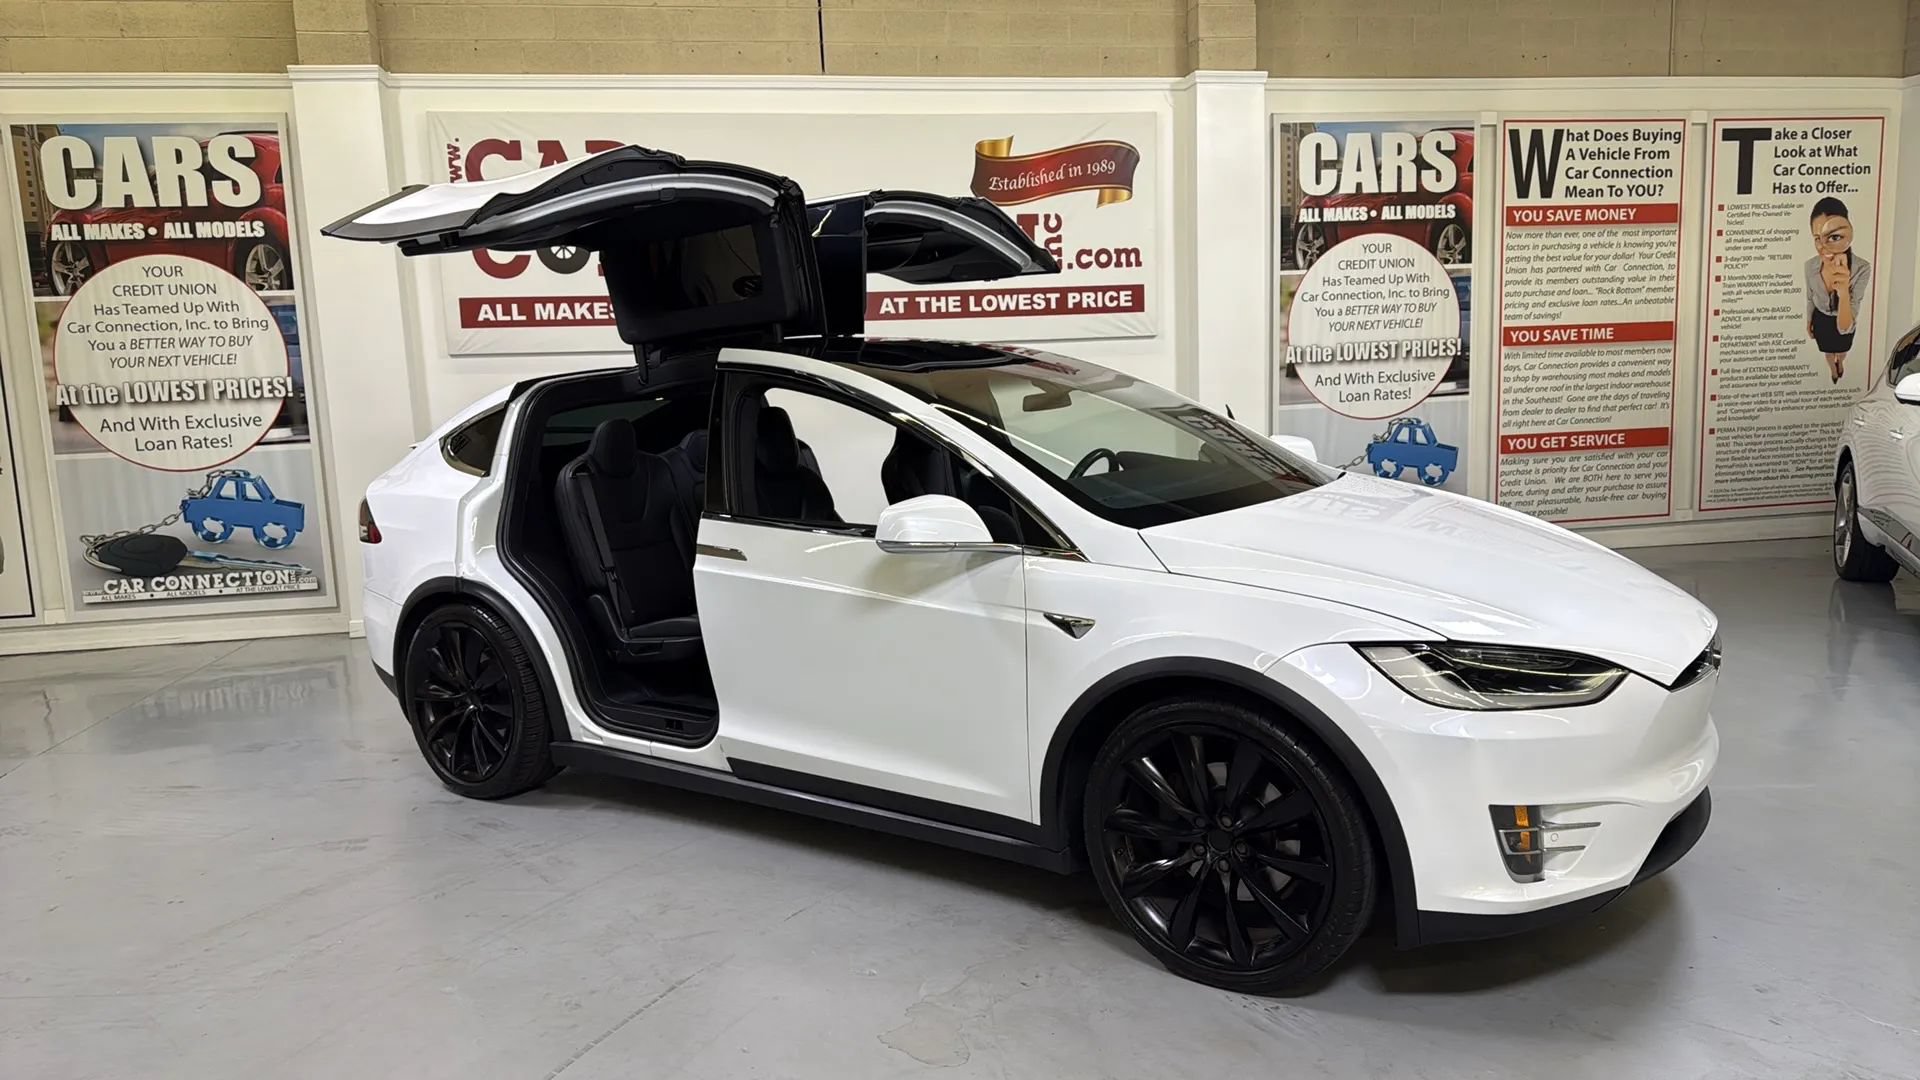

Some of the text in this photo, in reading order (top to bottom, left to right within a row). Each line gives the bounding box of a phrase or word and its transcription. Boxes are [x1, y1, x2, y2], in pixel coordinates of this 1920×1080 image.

[1594, 129, 1628, 141] Does
[1633, 129, 1681, 144] Buying
[1812, 127, 1851, 139] Closer
[1566, 147, 1670, 160] A Vehicle From
[1774, 145, 1857, 158] Look at What
[1299, 131, 1457, 196] CARS
[1774, 163, 1870, 176] Car Connection
[40, 135, 261, 209] CARS
[989, 160, 1115, 190] Established in 1989
[1565, 166, 1672, 179] Car Connection
[1565, 184, 1664, 198] Mean To YOU?
[1773, 181, 1858, 194] Has to Offer...
[1299, 205, 1456, 222] ALL MAKES ALL MODELS
[1513, 208, 1636, 222] YOU SAVE MONEY
[51, 221, 265, 240] ALL MAKES ALL MODELS
[1044, 213, 1062, 270] nc
[1067, 247, 1142, 269] .com
[1362, 243, 1392, 253] YOUR
[1541, 242, 1581, 251] purchasing
[1623, 241, 1653, 249] knowing
[1338, 258, 1415, 270] CREDIT UNION
[142, 266, 184, 277] YOUR
[1323, 273, 1429, 286] Has Teamed Up With
[112, 283, 217, 296] CREDIT UNION
[1301, 292, 1319, 302] Car
[1322, 290, 1385, 301] Connection,
[1388, 289, 1406, 298] Inc.
[1423, 288, 1449, 299] Bring
[94, 301, 240, 316] Has Teamed Up With
[880, 291, 1132, 314] AT THE LOWEST PRICE
[478, 303, 526, 321] ALL
[1315, 308, 1334, 317] You
[1346, 305, 1379, 315] BETTER
[1382, 304, 1401, 313] WAY
[1404, 303, 1416, 313] TO
[1419, 303, 1437, 312] BUY
[1533, 311, 1562, 320] savings!
[67, 318, 269, 333] Car Connection, Inc. to Bring
[1329, 318, 1423, 331] YOUR NEXT VEHICLE!
[1511, 328, 1614, 342] YOU SAVE TIME
[88, 340, 114, 351] You
[130, 338, 175, 349] BETTER
[179, 337, 205, 348] WAY
[210, 336, 225, 347] TO
[229, 336, 253, 346] BUY
[1286, 338, 1461, 363] At the LOWEST PRICES!
[110, 354, 237, 368] YOUR NEXT VEHICLE!
[1315, 370, 1435, 386] And With Exclusive
[56, 377, 293, 406] At the LOWEST PRICES!
[1339, 388, 1411, 402] Loan Rates!
[100, 414, 262, 432] And With Exclusive
[1512, 421, 1529, 429] right
[1570, 416, 1612, 424] Connection!
[136, 434, 232, 451] Loan Rates!
[1508, 434, 1625, 450] YOU GET SERVICE
[1500, 468, 1532, 477] purchase
[1542, 466, 1568, 476] priority
[1596, 463, 1634, 471] Connection
[1652, 462, 1667, 470] your
[104, 578, 145, 594] CAR
[151, 570, 291, 592] CONNECTION
